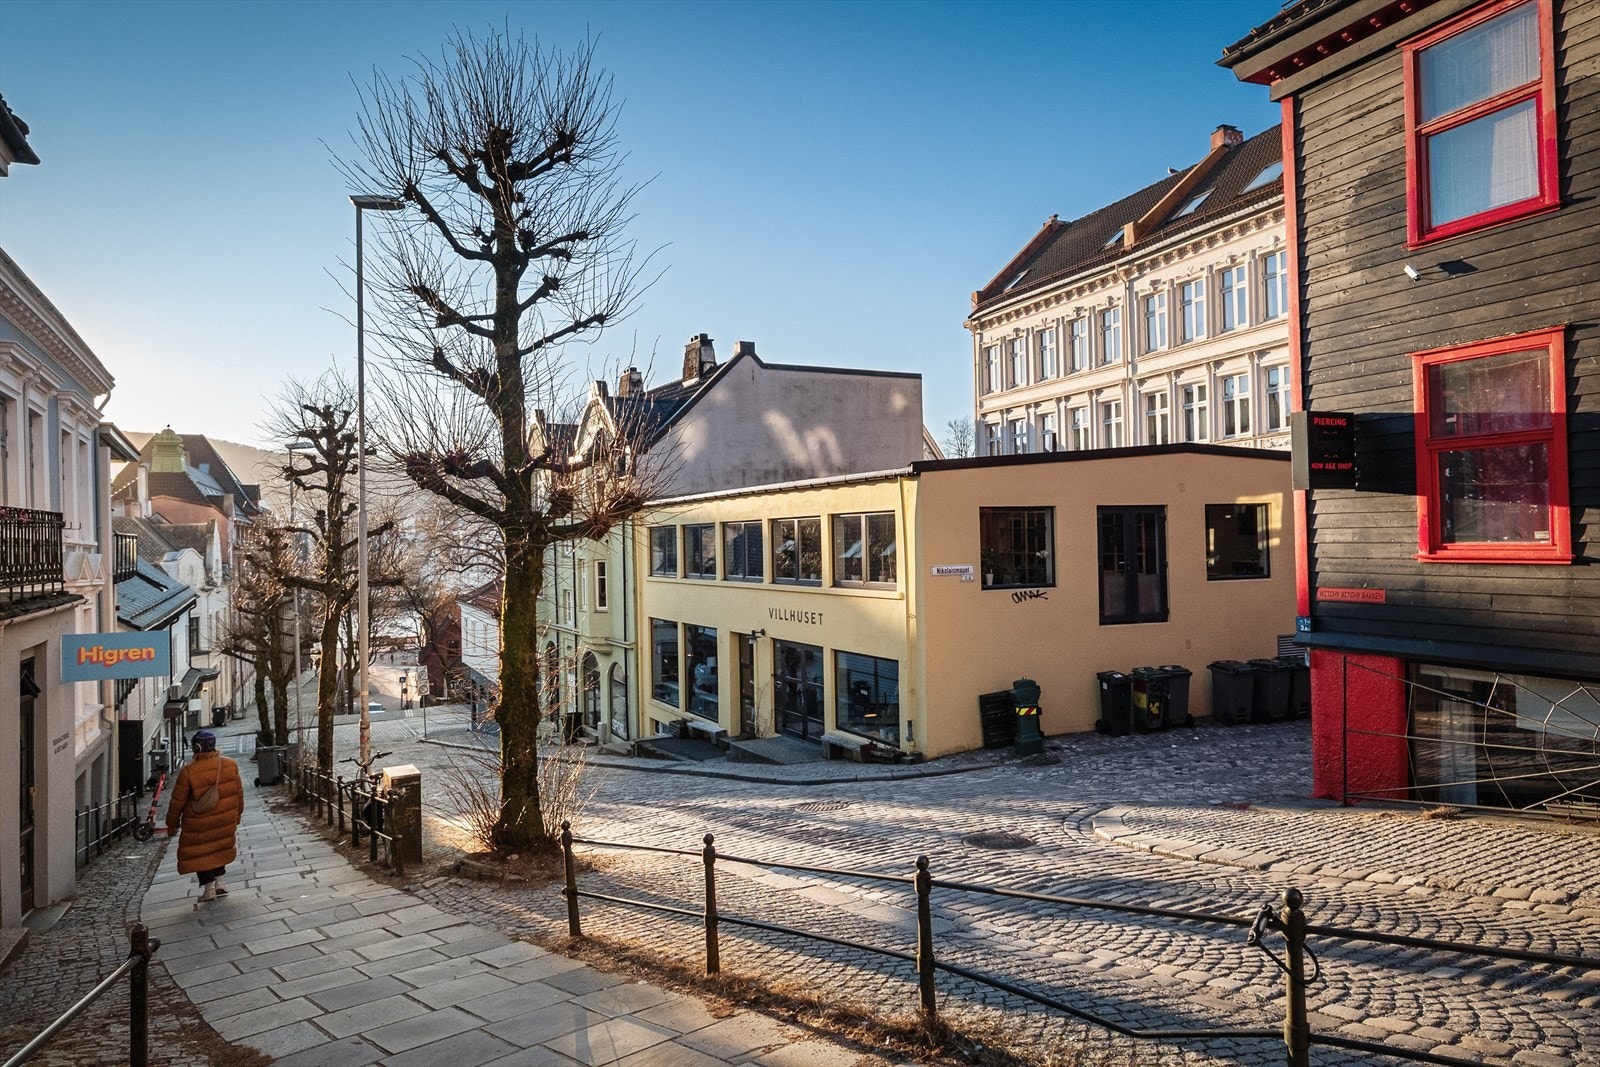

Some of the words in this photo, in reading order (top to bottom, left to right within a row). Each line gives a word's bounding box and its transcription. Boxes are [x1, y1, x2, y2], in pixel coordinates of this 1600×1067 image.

[1313, 417, 1347, 426] PIERCING
[768, 607, 823, 626] VILLHUSET
[77, 645, 155, 668] Higren
